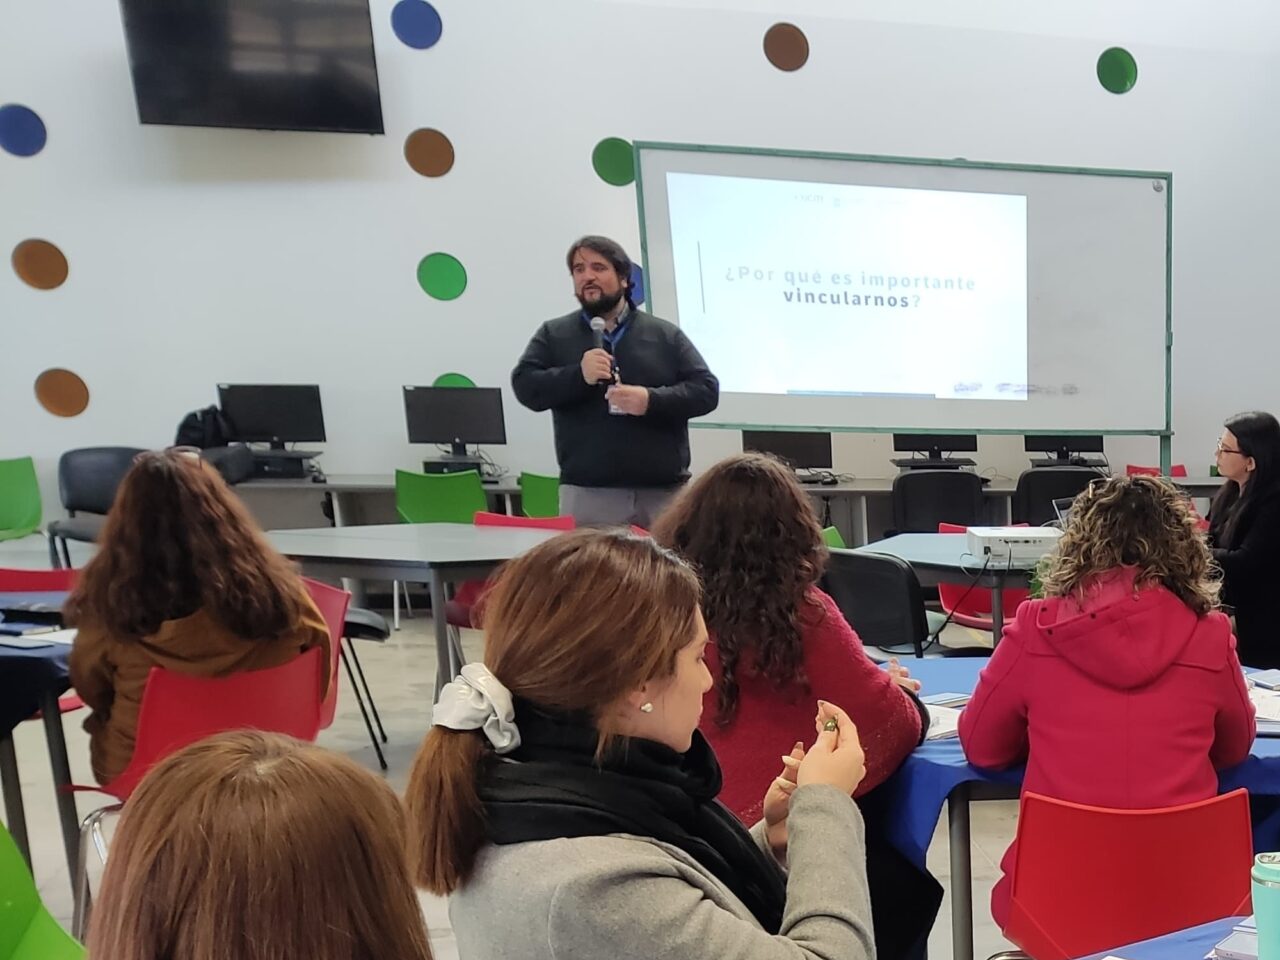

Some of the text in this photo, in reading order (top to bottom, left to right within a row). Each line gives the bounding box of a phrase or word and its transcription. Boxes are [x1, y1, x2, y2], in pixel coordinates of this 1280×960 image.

[725, 265, 976, 291] ¿Por qué es importante
[783, 287, 921, 308] vincularnos?
